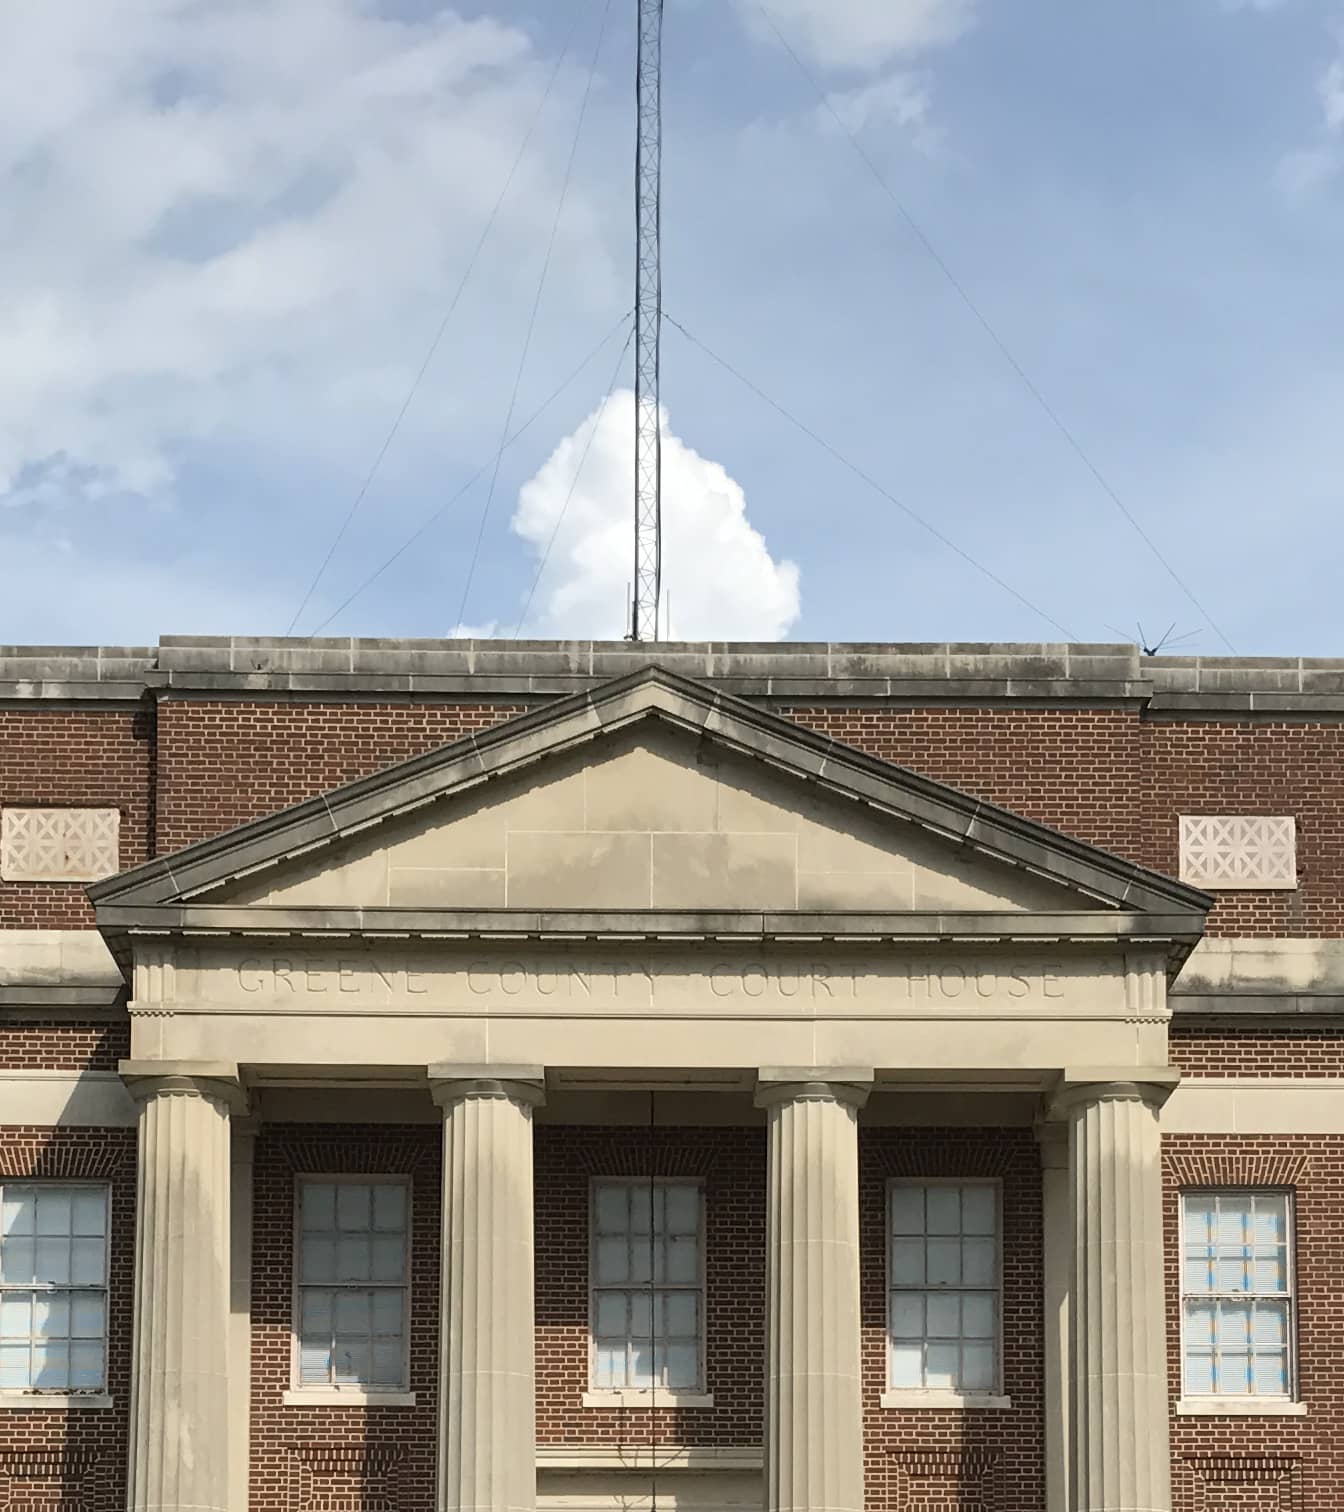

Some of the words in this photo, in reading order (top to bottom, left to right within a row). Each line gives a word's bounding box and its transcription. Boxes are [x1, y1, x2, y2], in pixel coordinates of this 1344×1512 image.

[236, 957, 431, 995] GREENE
[464, 960, 671, 998] COUNTY
[707, 961, 872, 998] COURT
[903, 962, 1066, 999] HOUSE
